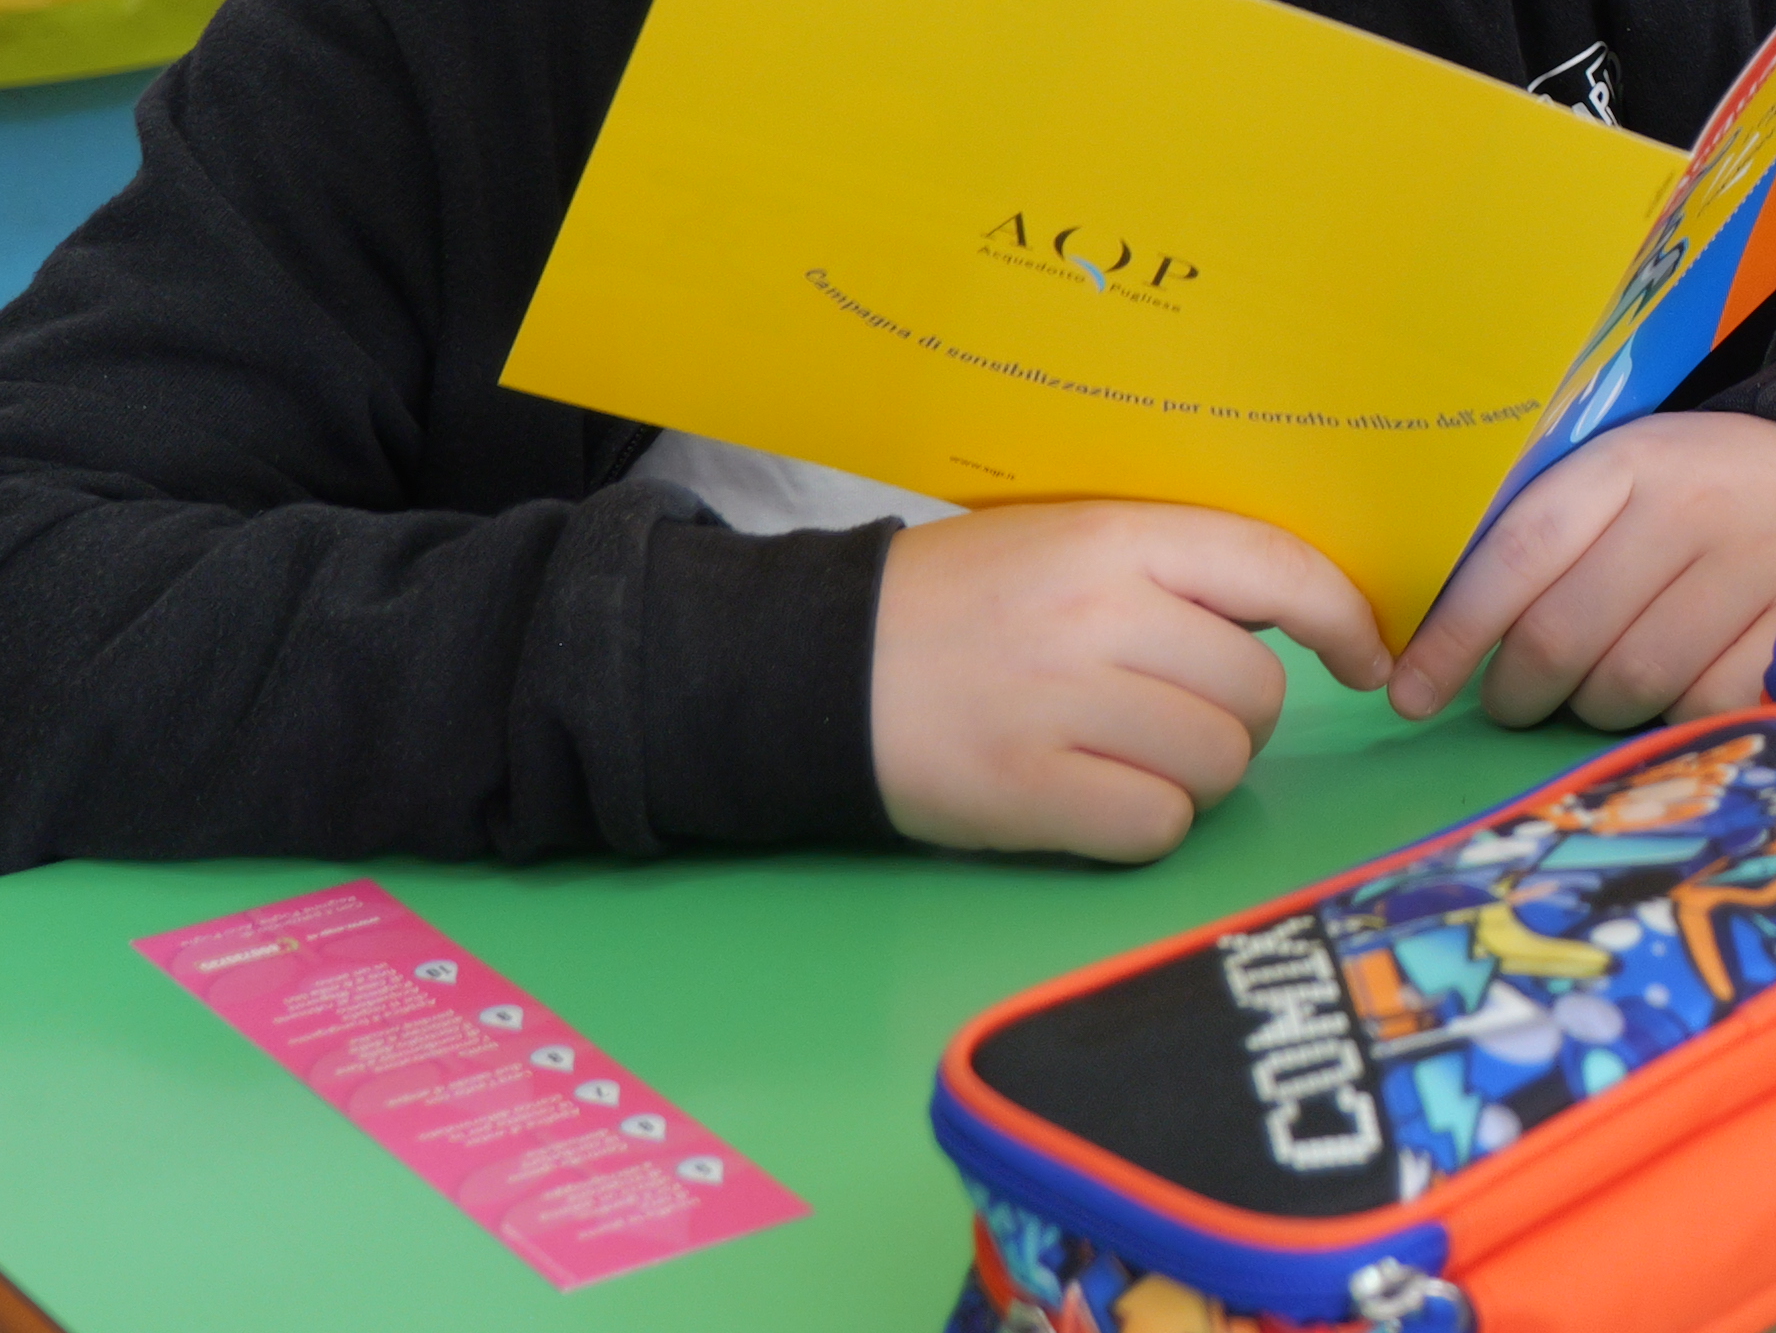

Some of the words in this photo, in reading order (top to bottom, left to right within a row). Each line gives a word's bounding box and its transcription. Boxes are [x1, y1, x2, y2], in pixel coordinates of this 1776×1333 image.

[975, 242, 1087, 285] Acquedotto
[1109, 281, 1182, 314] Pugliese
[802, 267, 913, 341] Campagna
[916, 333, 943, 354] di
[945, 345, 1156, 410] sensibilizzazione
[1161, 397, 1201, 418] per
[1209, 404, 1242, 421] un
[1247, 405, 1341, 430] corretto
[1345, 415, 1430, 431] utilizzo
[1434, 396, 1541, 431] dell'acqua
